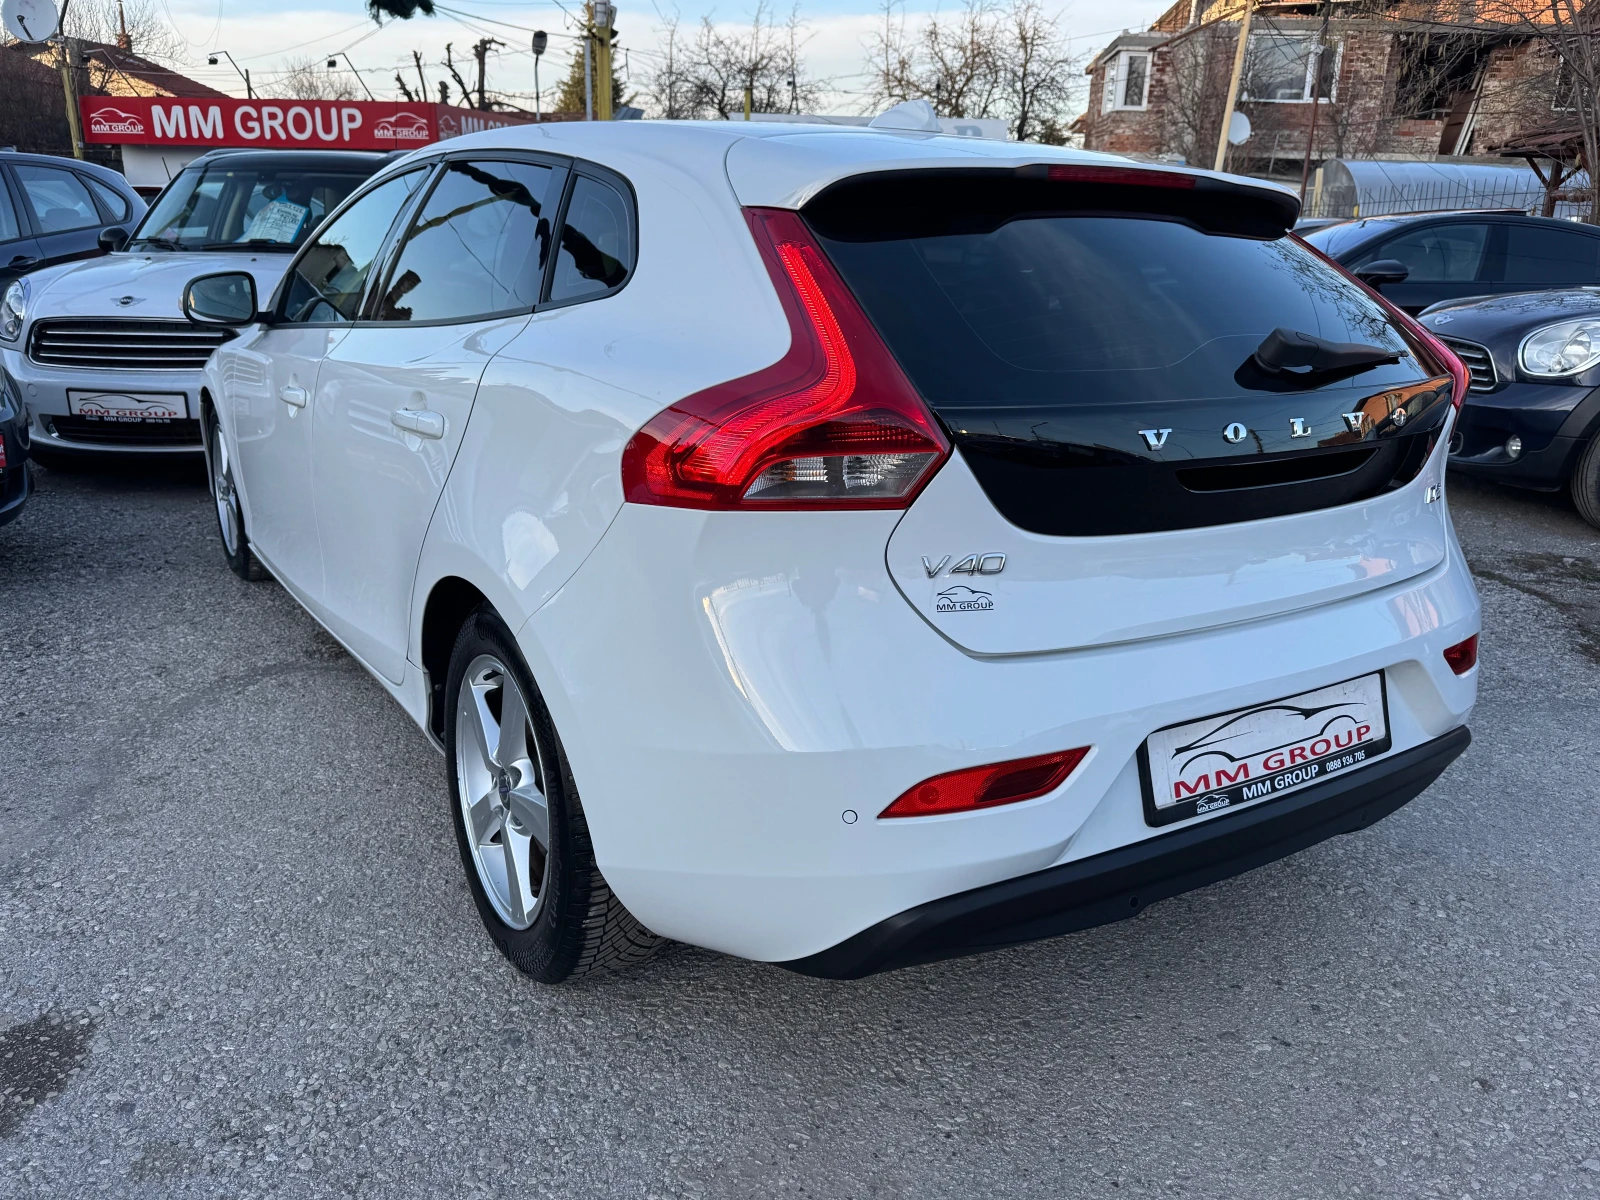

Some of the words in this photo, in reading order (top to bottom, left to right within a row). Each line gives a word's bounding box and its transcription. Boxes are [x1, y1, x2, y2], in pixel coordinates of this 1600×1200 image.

[91, 124, 109, 132] MM
[112, 124, 144, 132] GROUP
[151, 105, 224, 139] MM
[234, 106, 363, 142] GROUP
[374, 129, 393, 137] MM
[396, 129, 429, 138] GROUP
[79, 408, 110, 416] MM
[116, 410, 178, 418] GROUP
[1138, 407, 1408, 451] VOLVO
[921, 552, 1007, 579] V40
[936, 603, 957, 611] MM
[959, 602, 994, 610] GROUP
[1173, 763, 1250, 799] MM
[1262, 724, 1371, 772] GROUP
[1242, 782, 1271, 800] MM
[1274, 764, 1319, 790] GROUP
[1325, 759, 1342, 772] 0888
[1342, 756, 1354, 767] 936
[1355, 750, 1366, 762] 705
